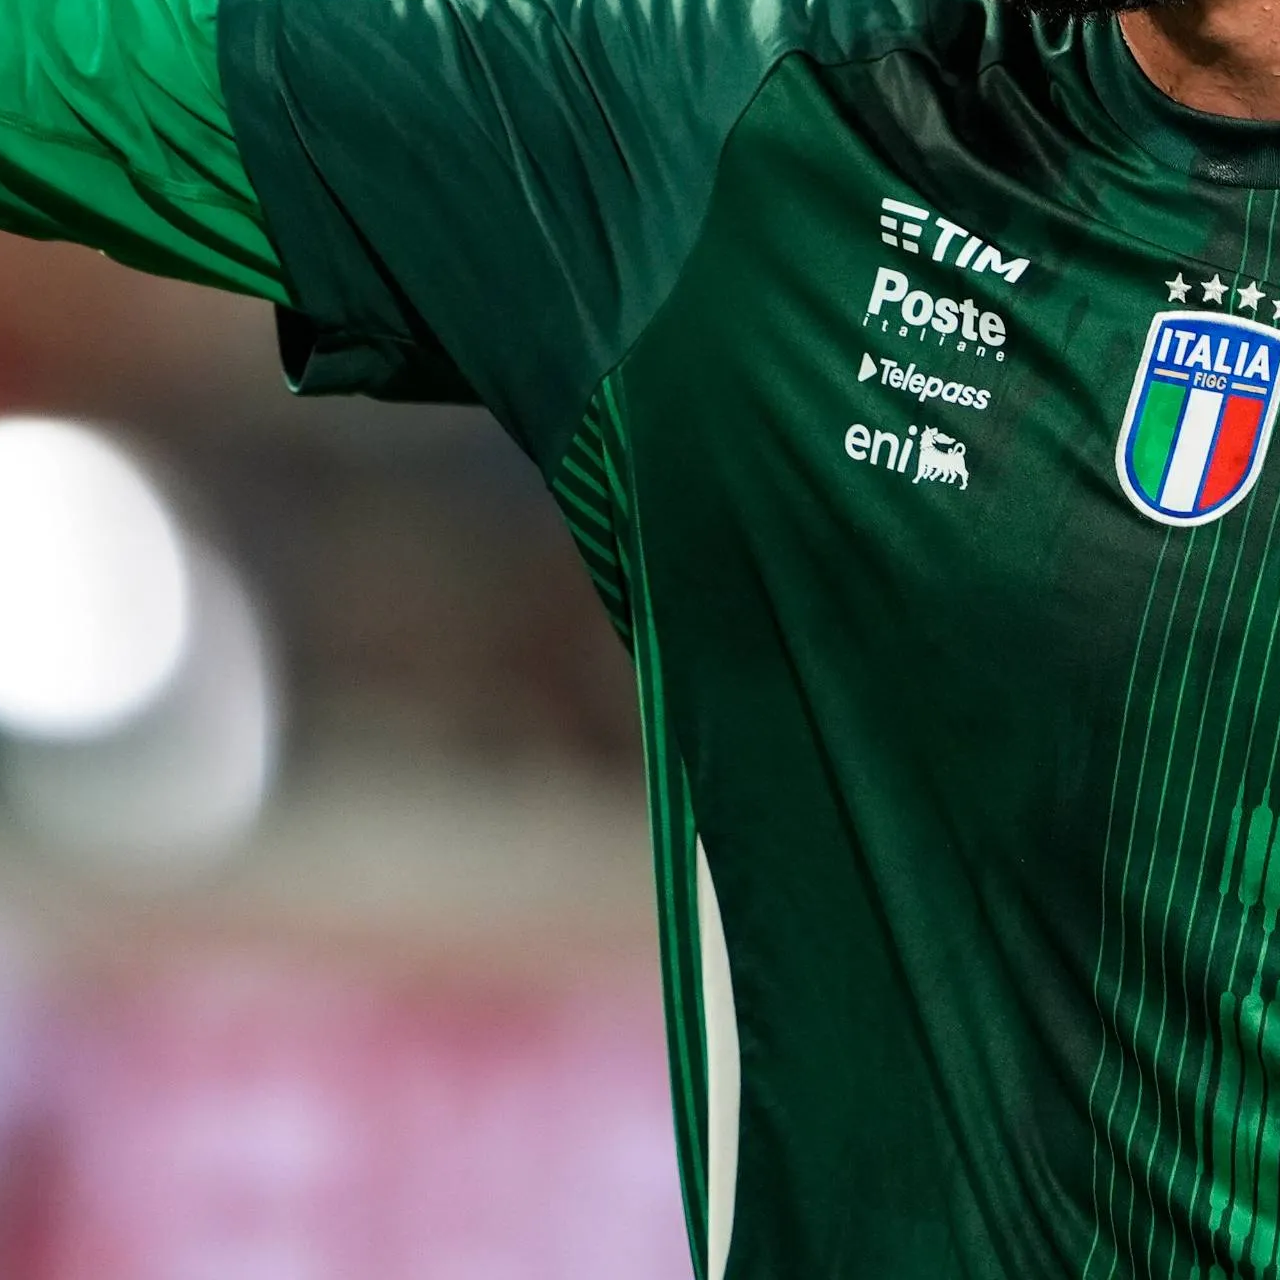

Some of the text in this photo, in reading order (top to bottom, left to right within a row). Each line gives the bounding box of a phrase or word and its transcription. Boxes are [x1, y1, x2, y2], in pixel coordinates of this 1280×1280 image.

[932, 217, 1031, 283] TIM
[867, 267, 1006, 347] Poste
[862, 313, 1006, 362] italiane
[1156, 327, 1271, 382] ITALIA
[880, 357, 991, 410] Telepass
[1193, 371, 1228, 390] FIGC
[844, 424, 918, 473] eni
